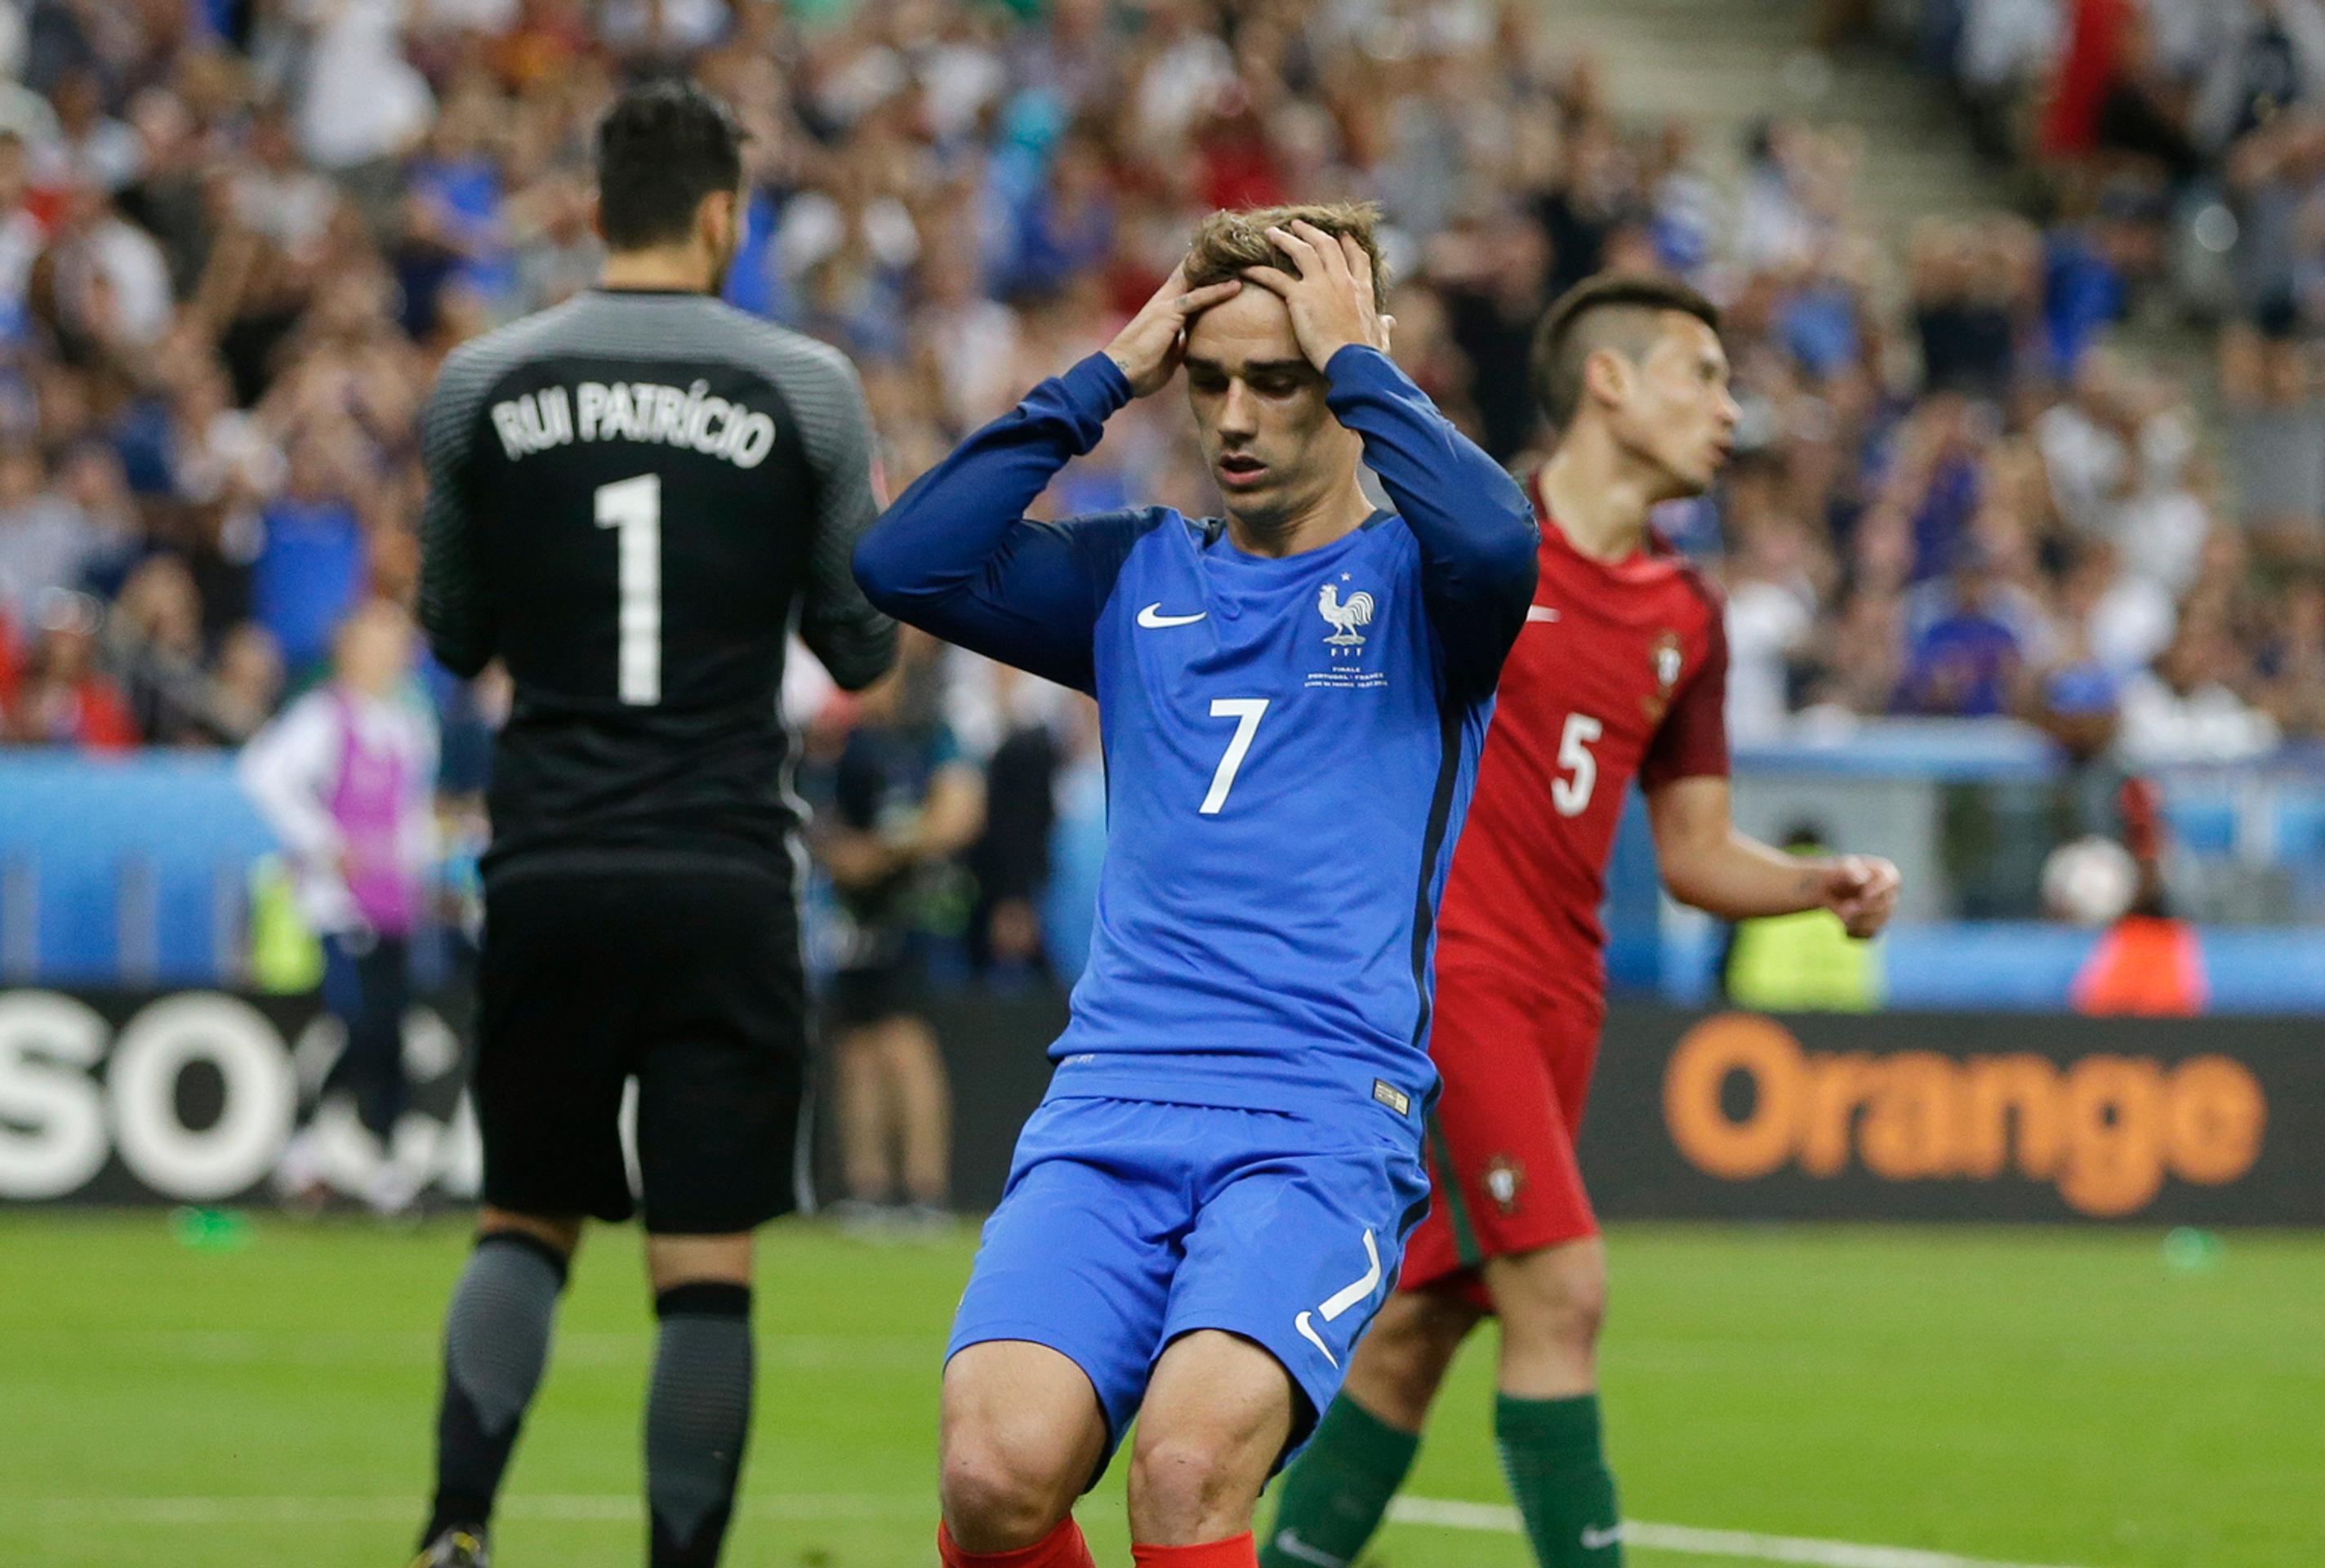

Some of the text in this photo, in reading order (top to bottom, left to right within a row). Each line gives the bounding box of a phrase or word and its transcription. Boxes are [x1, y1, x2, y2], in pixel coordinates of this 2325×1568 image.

[491, 378, 776, 469] RUI PATRÍCIO
[594, 472, 661, 706] 1
[1198, 697, 1271, 814] 7
[1551, 710, 1603, 817] 5
[1663, 1012, 2268, 1218] Orange
[1318, 1228, 1382, 1322] 7
